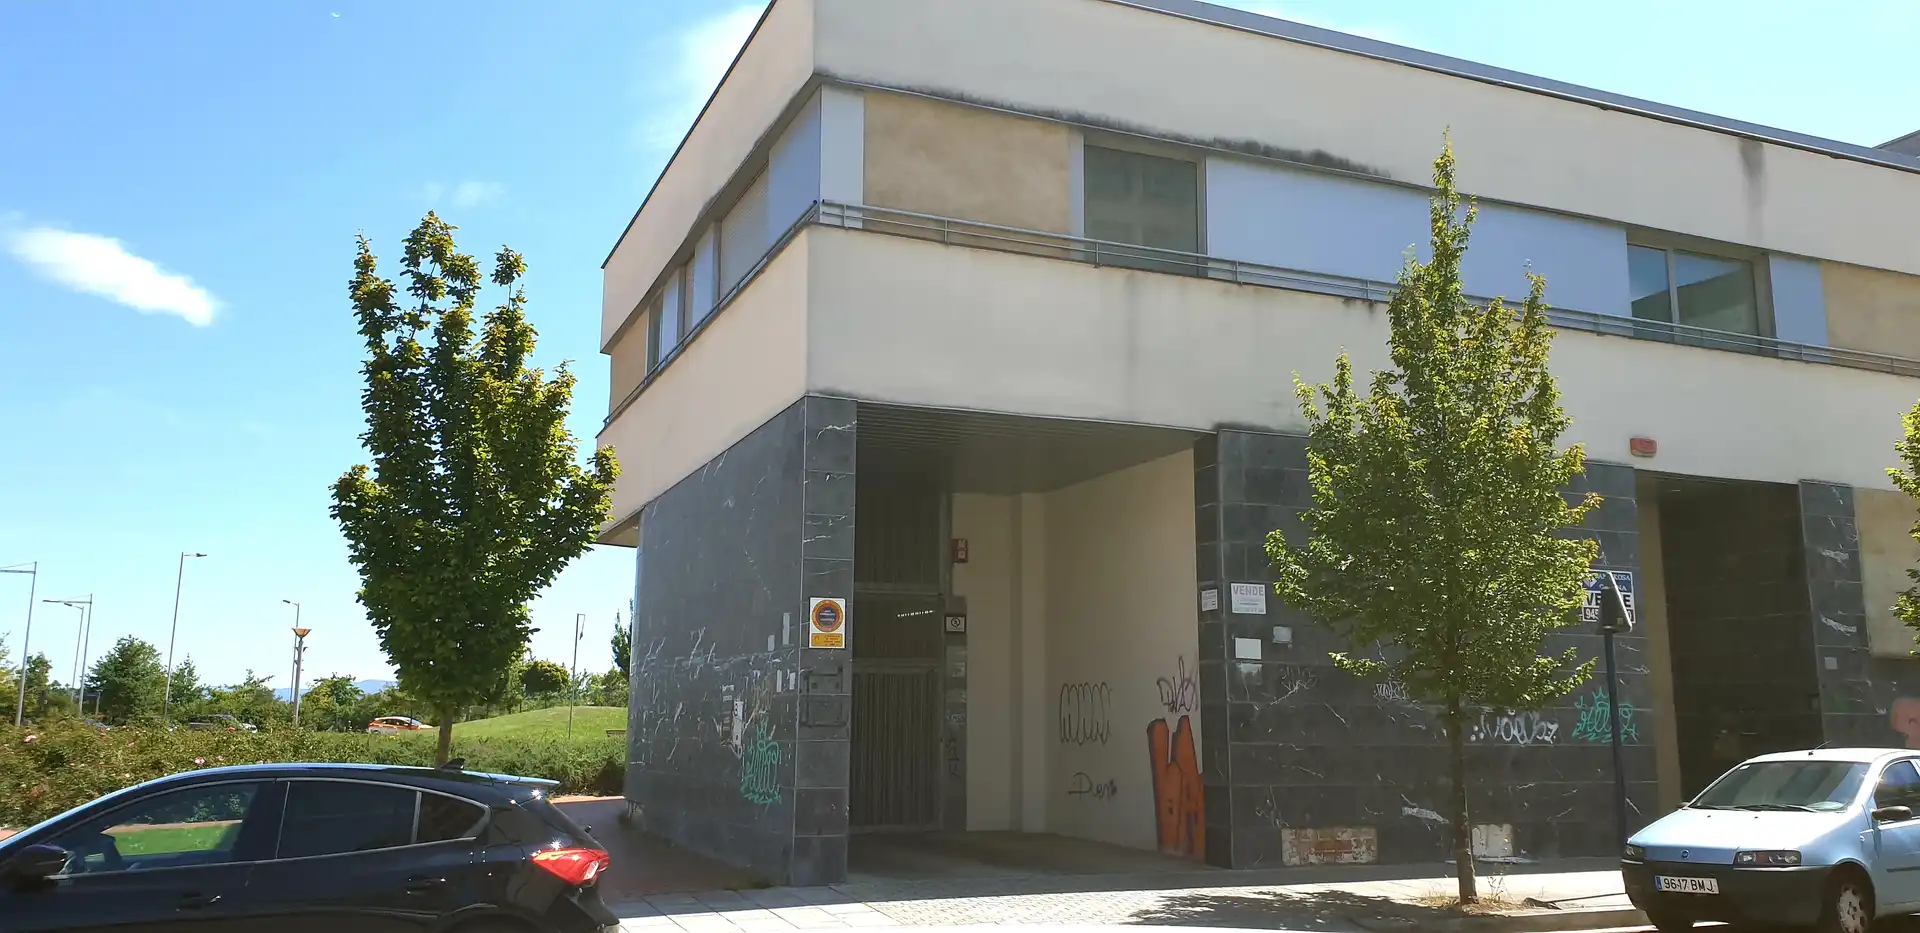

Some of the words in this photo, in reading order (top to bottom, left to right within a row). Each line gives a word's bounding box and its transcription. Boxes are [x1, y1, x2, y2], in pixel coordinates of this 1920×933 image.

[1233, 585, 1264, 596] VENDE
[1587, 592, 1632, 607] VEE
[1663, 878, 1688, 890] 9617
[1690, 879, 1715, 892] BMJ
